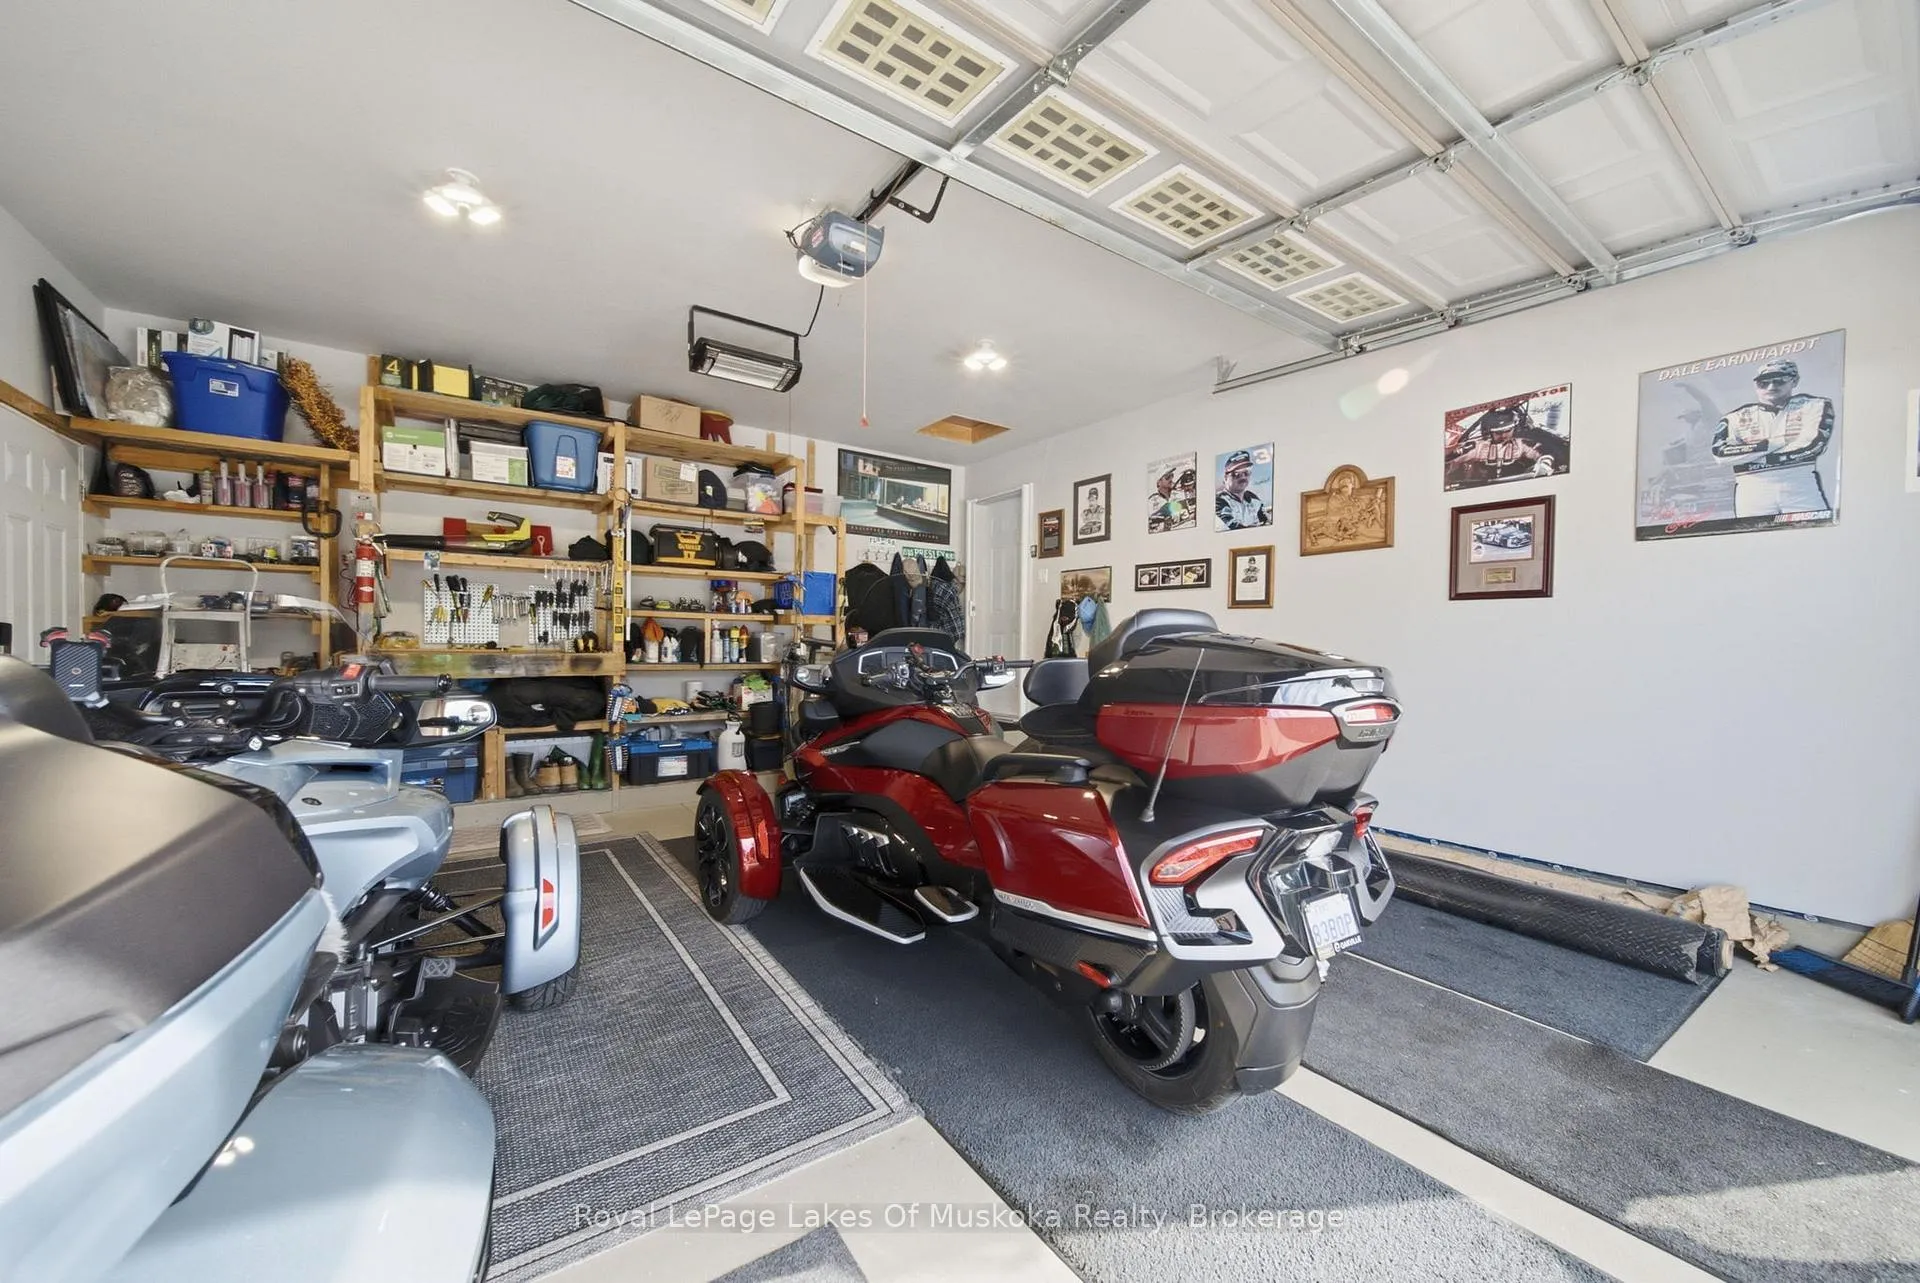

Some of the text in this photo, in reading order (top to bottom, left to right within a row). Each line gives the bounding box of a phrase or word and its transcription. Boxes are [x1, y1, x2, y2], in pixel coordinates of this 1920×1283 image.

[386, 359, 400, 374] 4
[1658, 337, 1820, 381] DALE EARNHARDT
[1253, 449, 1271, 464] 3
